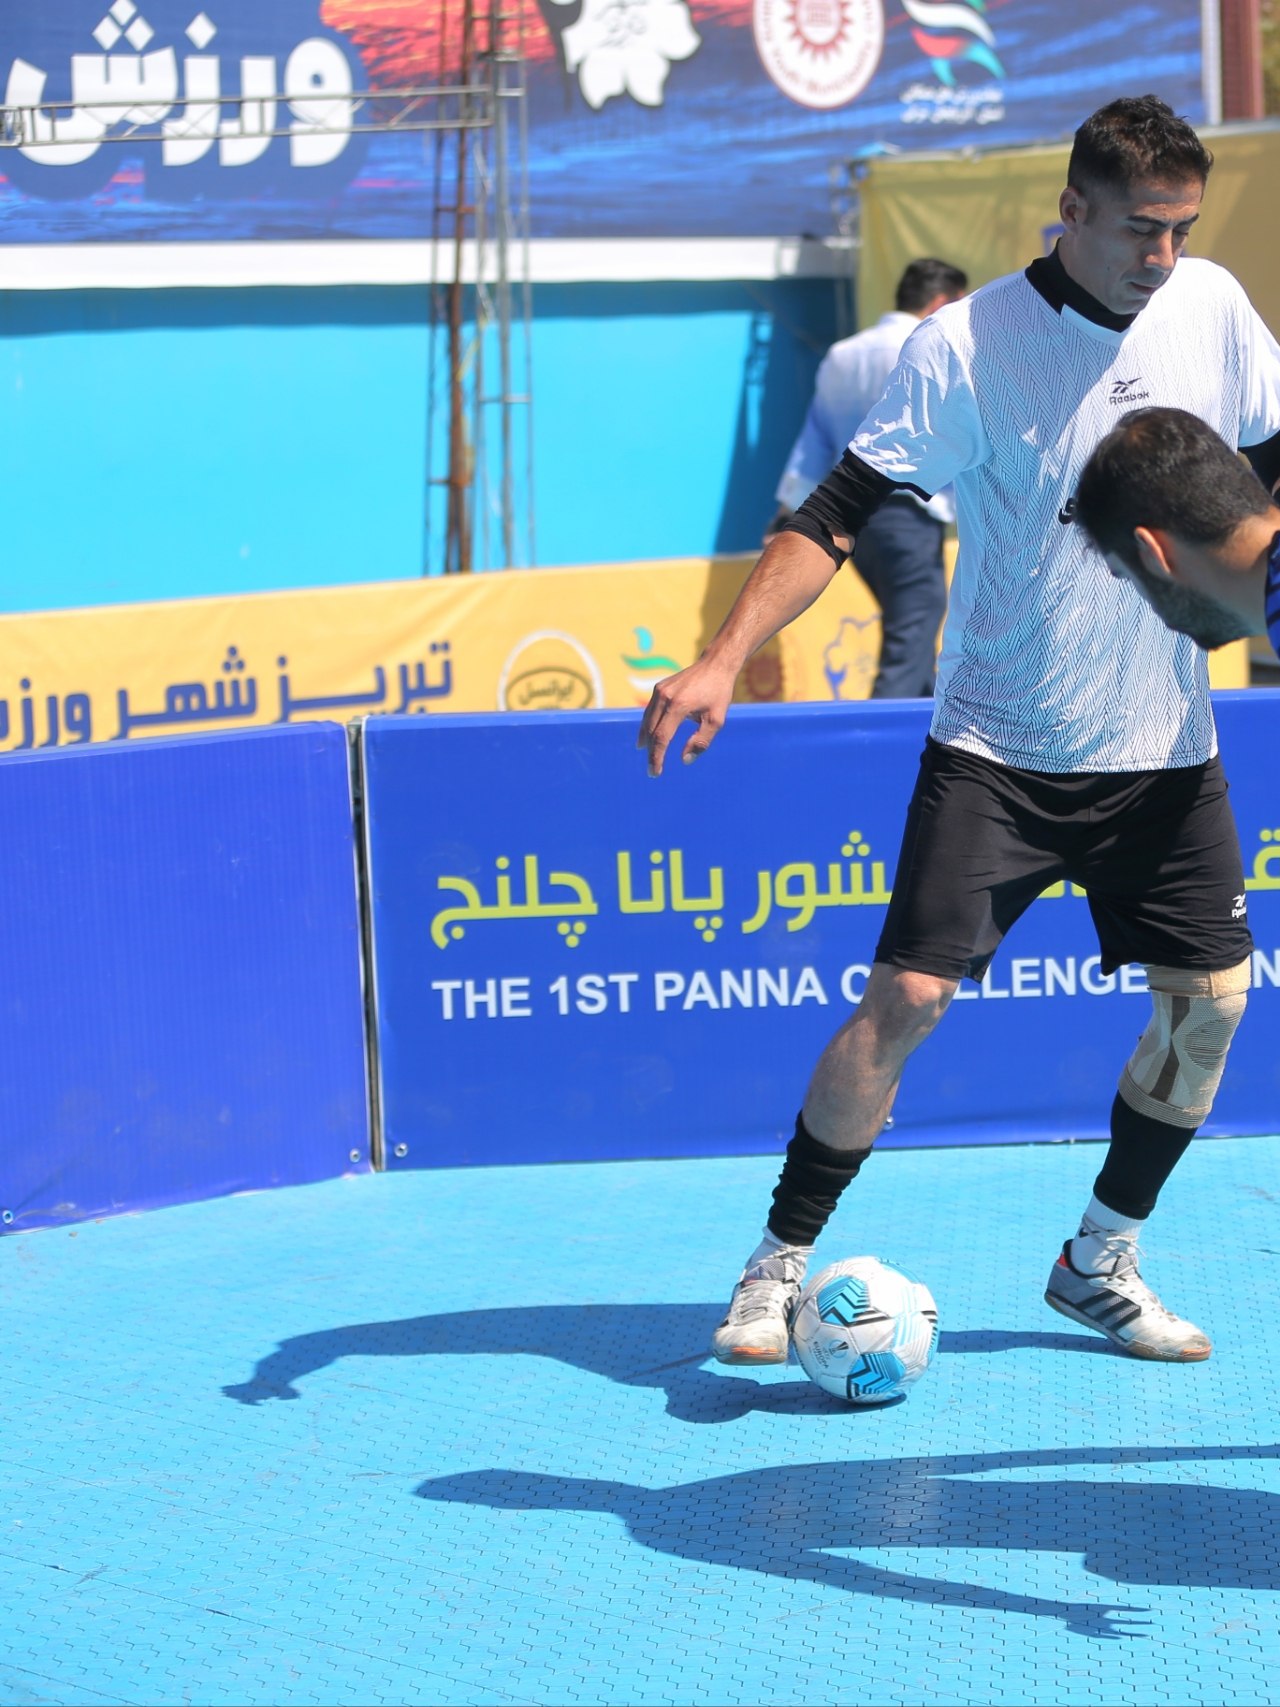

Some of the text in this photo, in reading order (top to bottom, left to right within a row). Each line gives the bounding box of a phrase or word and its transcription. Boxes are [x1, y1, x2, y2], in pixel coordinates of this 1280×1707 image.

[4, 0, 354, 167] ورزش
[1109, 390, 1150, 405] Reebok
[0, 676, 92, 751] ورز
[109, 645, 258, 740] شهر
[430, 830, 893, 950] شور پانا چلنج
[431, 977, 533, 1021] THE
[548, 972, 640, 1016] 1ST
[654, 966, 829, 1011] PANNA
[839, 956, 1149, 1005] CLLENGE
